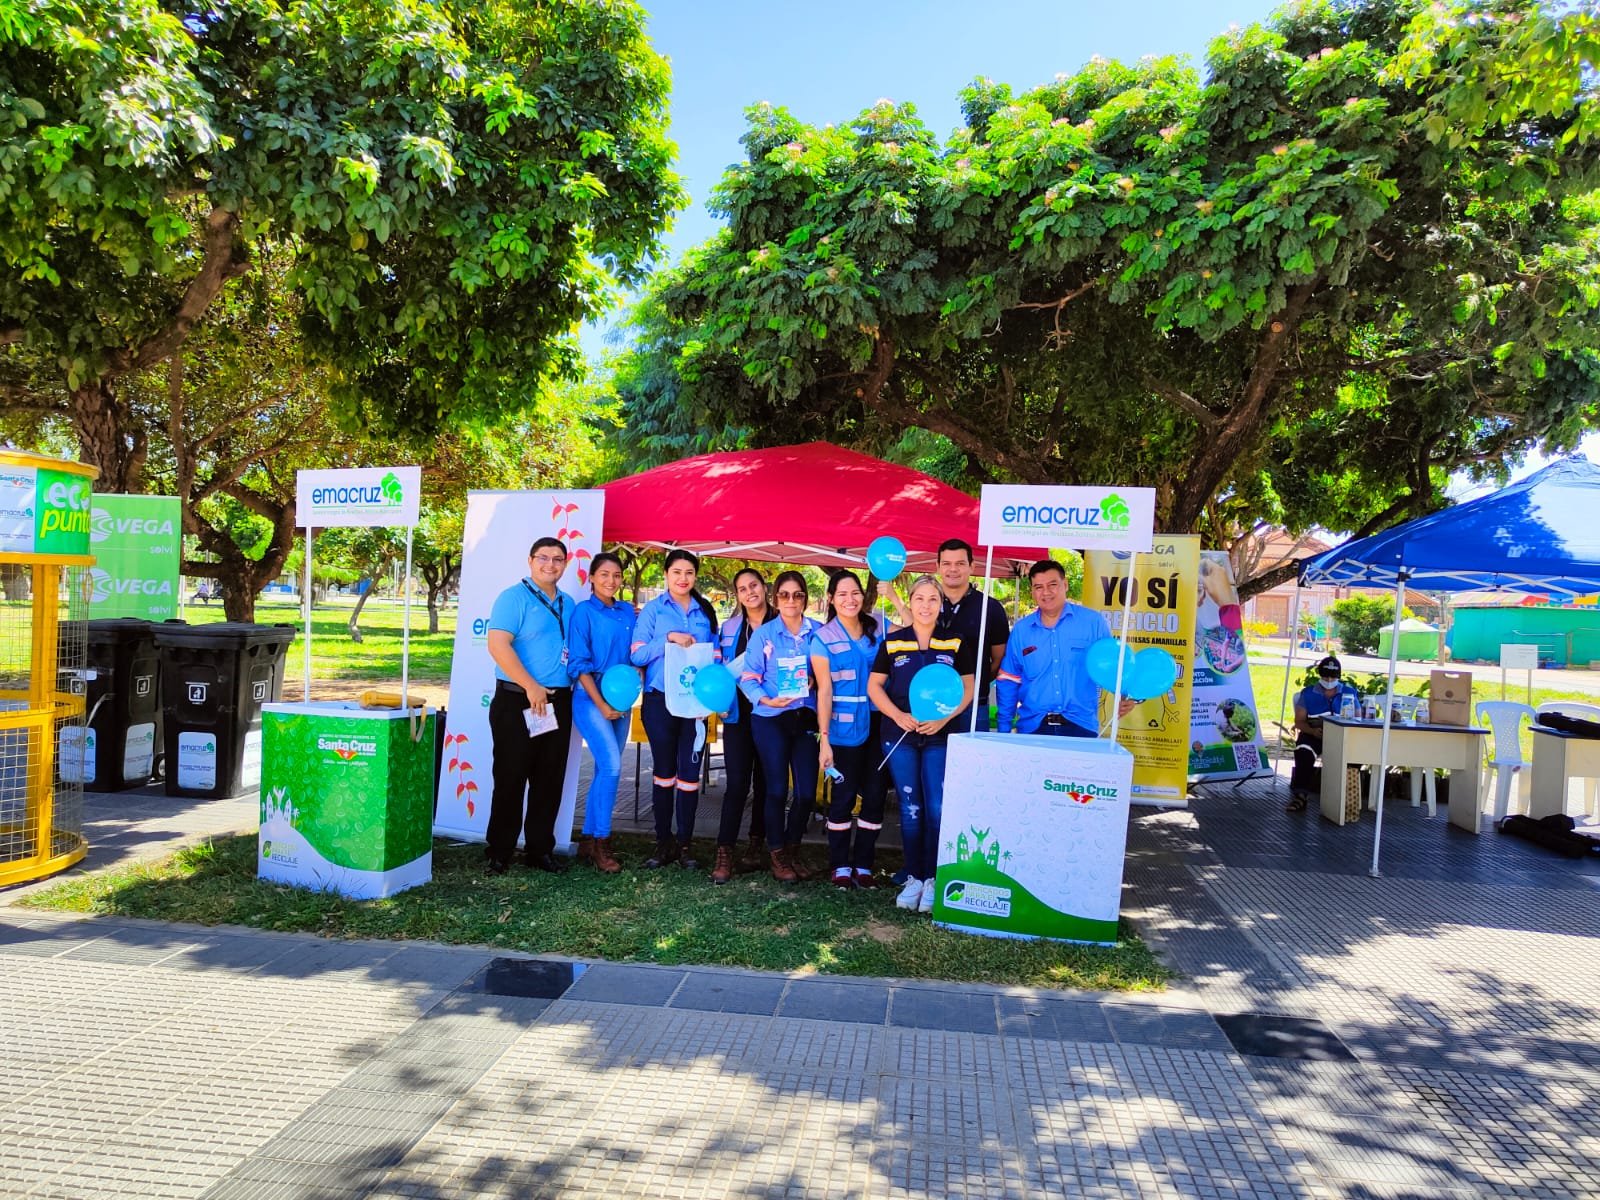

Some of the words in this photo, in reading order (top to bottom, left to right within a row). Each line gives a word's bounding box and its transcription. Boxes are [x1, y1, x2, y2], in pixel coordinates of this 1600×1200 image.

[312, 486, 382, 504] emacruz
[1002, 506, 1100, 526] emacruz
[117, 518, 173, 535] VEGA
[115, 579, 171, 595] VEGA
[1100, 576, 1138, 607] YO
[1147, 572, 1180, 609] SÍ
[1151, 638, 1187, 647] AMARILLAS
[318, 738, 349, 750] Santa
[350, 740, 376, 752] Cruz
[1043, 778, 1085, 794] Santa
[1086, 783, 1118, 798] Cruz
[965, 896, 1009, 911] RECICLAJE
